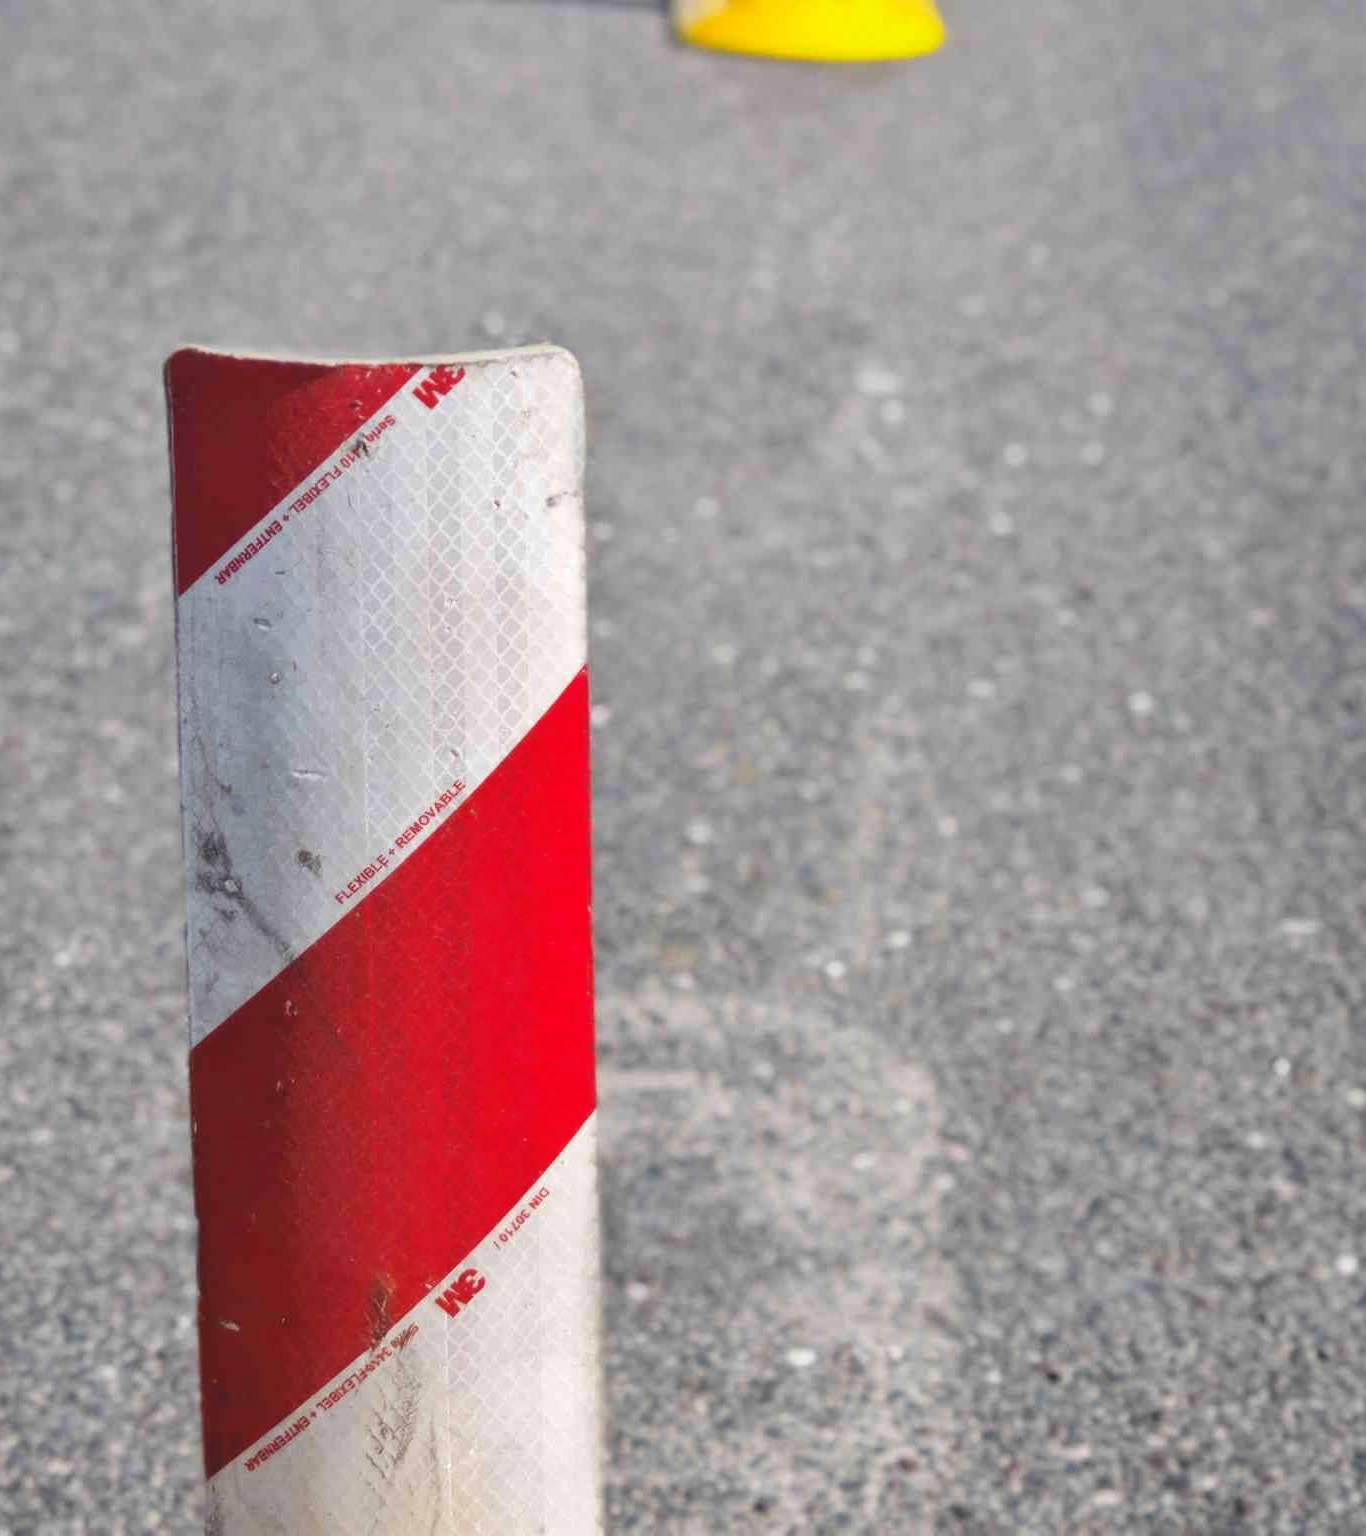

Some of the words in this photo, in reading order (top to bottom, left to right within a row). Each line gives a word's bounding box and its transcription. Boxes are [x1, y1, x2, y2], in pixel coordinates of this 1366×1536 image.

[413, 364, 465, 408] 3M
[290, 466, 342, 512] FLEXIBEL
[214, 520, 283, 585] ENTFERNBAR
[335, 854, 389, 905] FLEXIBLE
[395, 779, 465, 849] REMOVABLE
[528, 1187, 550, 1210] DIN
[499, 1209, 531, 1243] 30710
[435, 1268, 486, 1318] 3M
[244, 1415, 311, 1472] ENTFERNBAR
